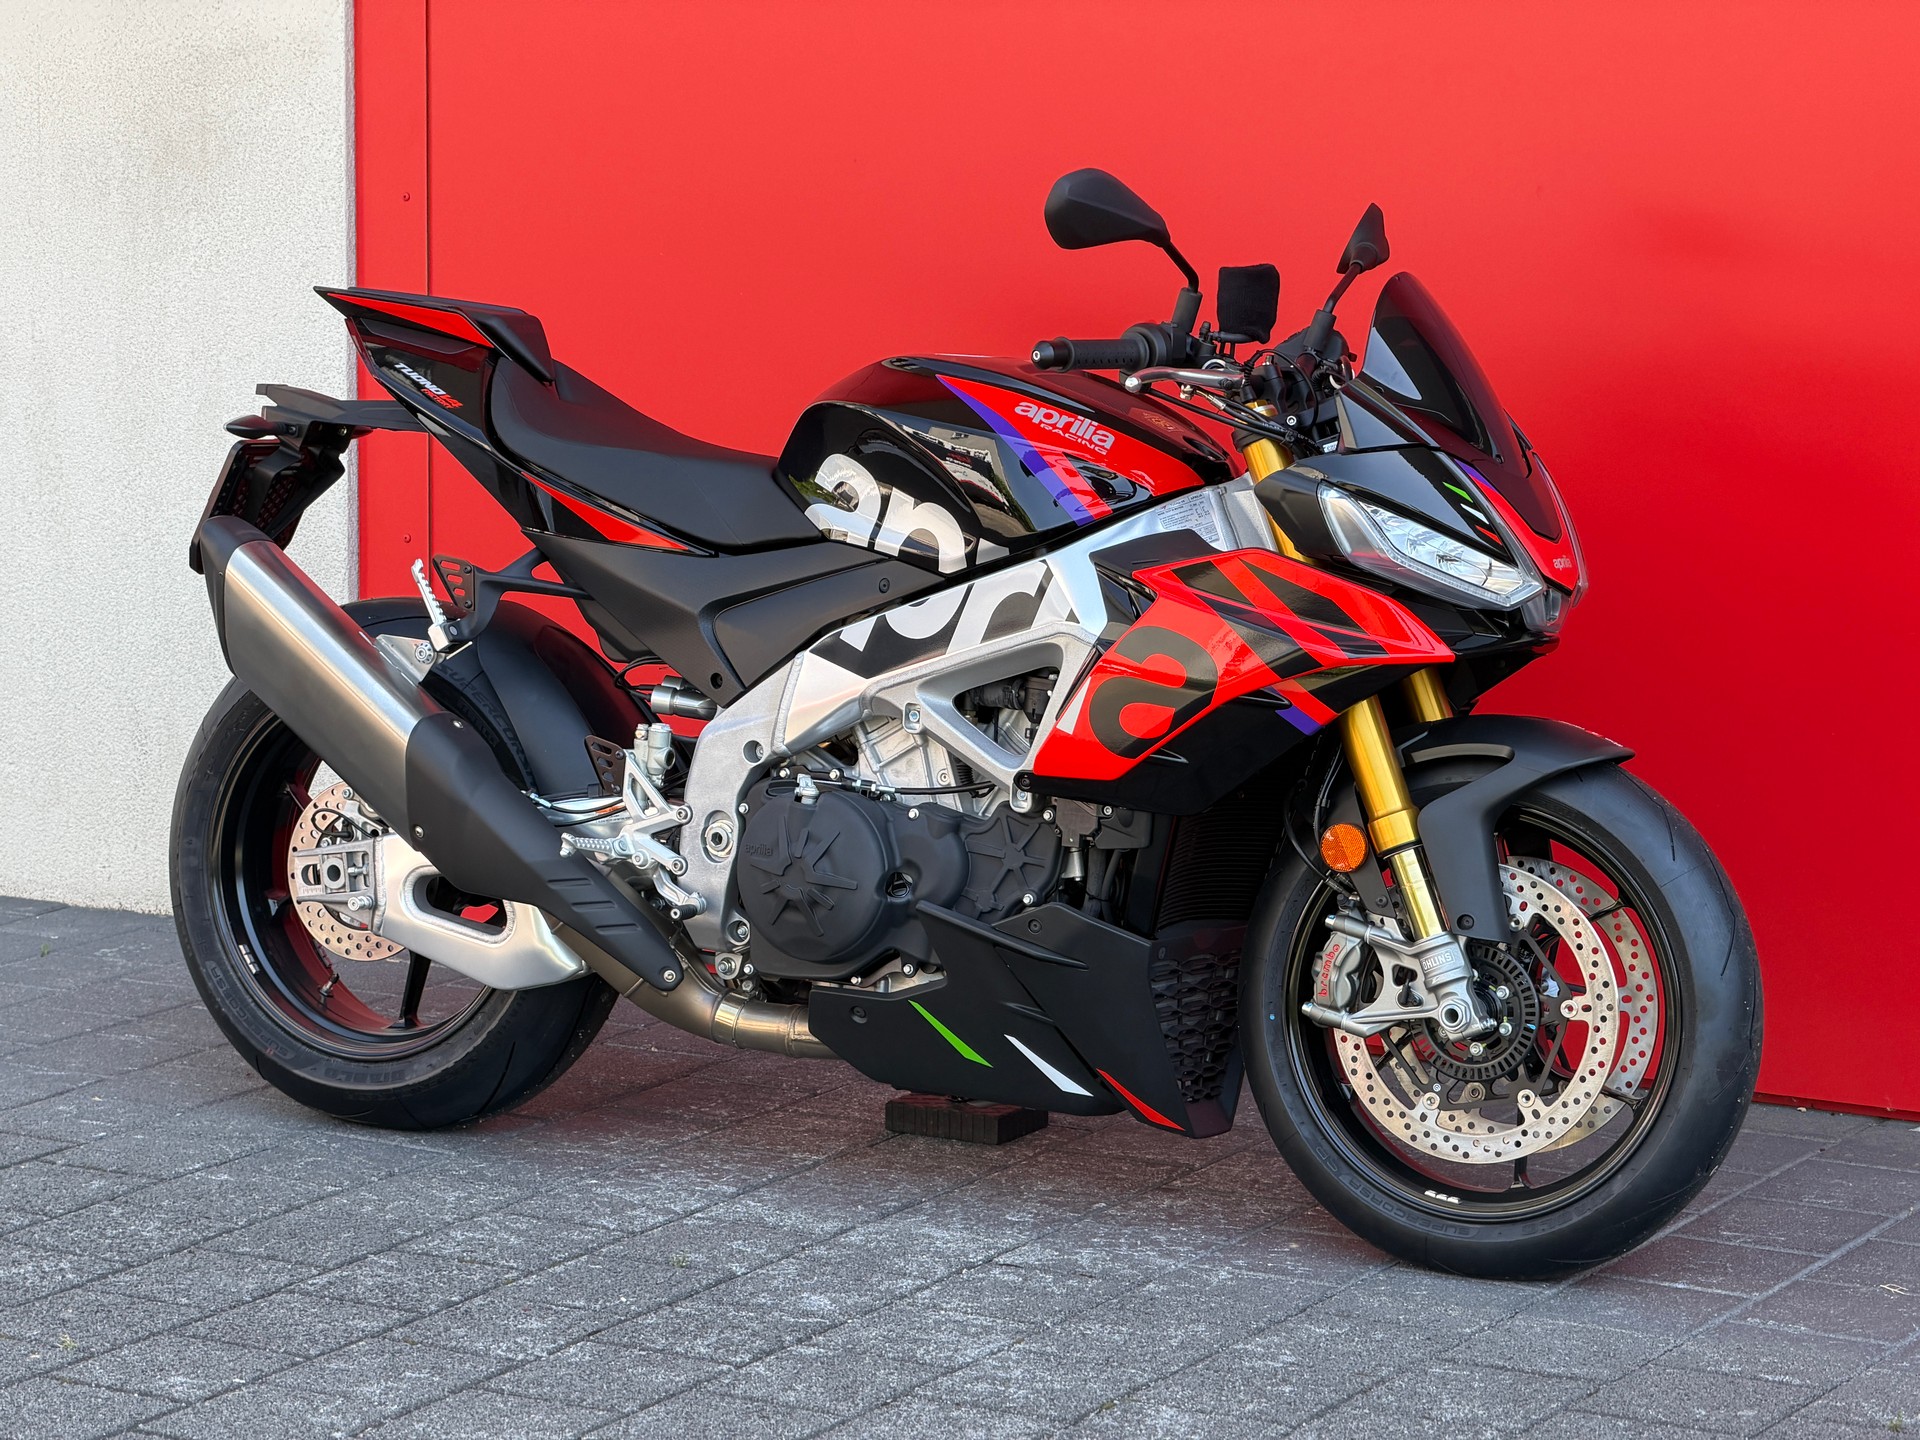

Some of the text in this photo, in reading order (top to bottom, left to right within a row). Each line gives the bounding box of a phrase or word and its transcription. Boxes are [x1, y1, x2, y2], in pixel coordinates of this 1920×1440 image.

[1014, 401, 1116, 449] aprilia
[1040, 423, 1108, 456] RACING
[745, 842, 774, 857] aprilia
[1318, 943, 1341, 998] brembo
